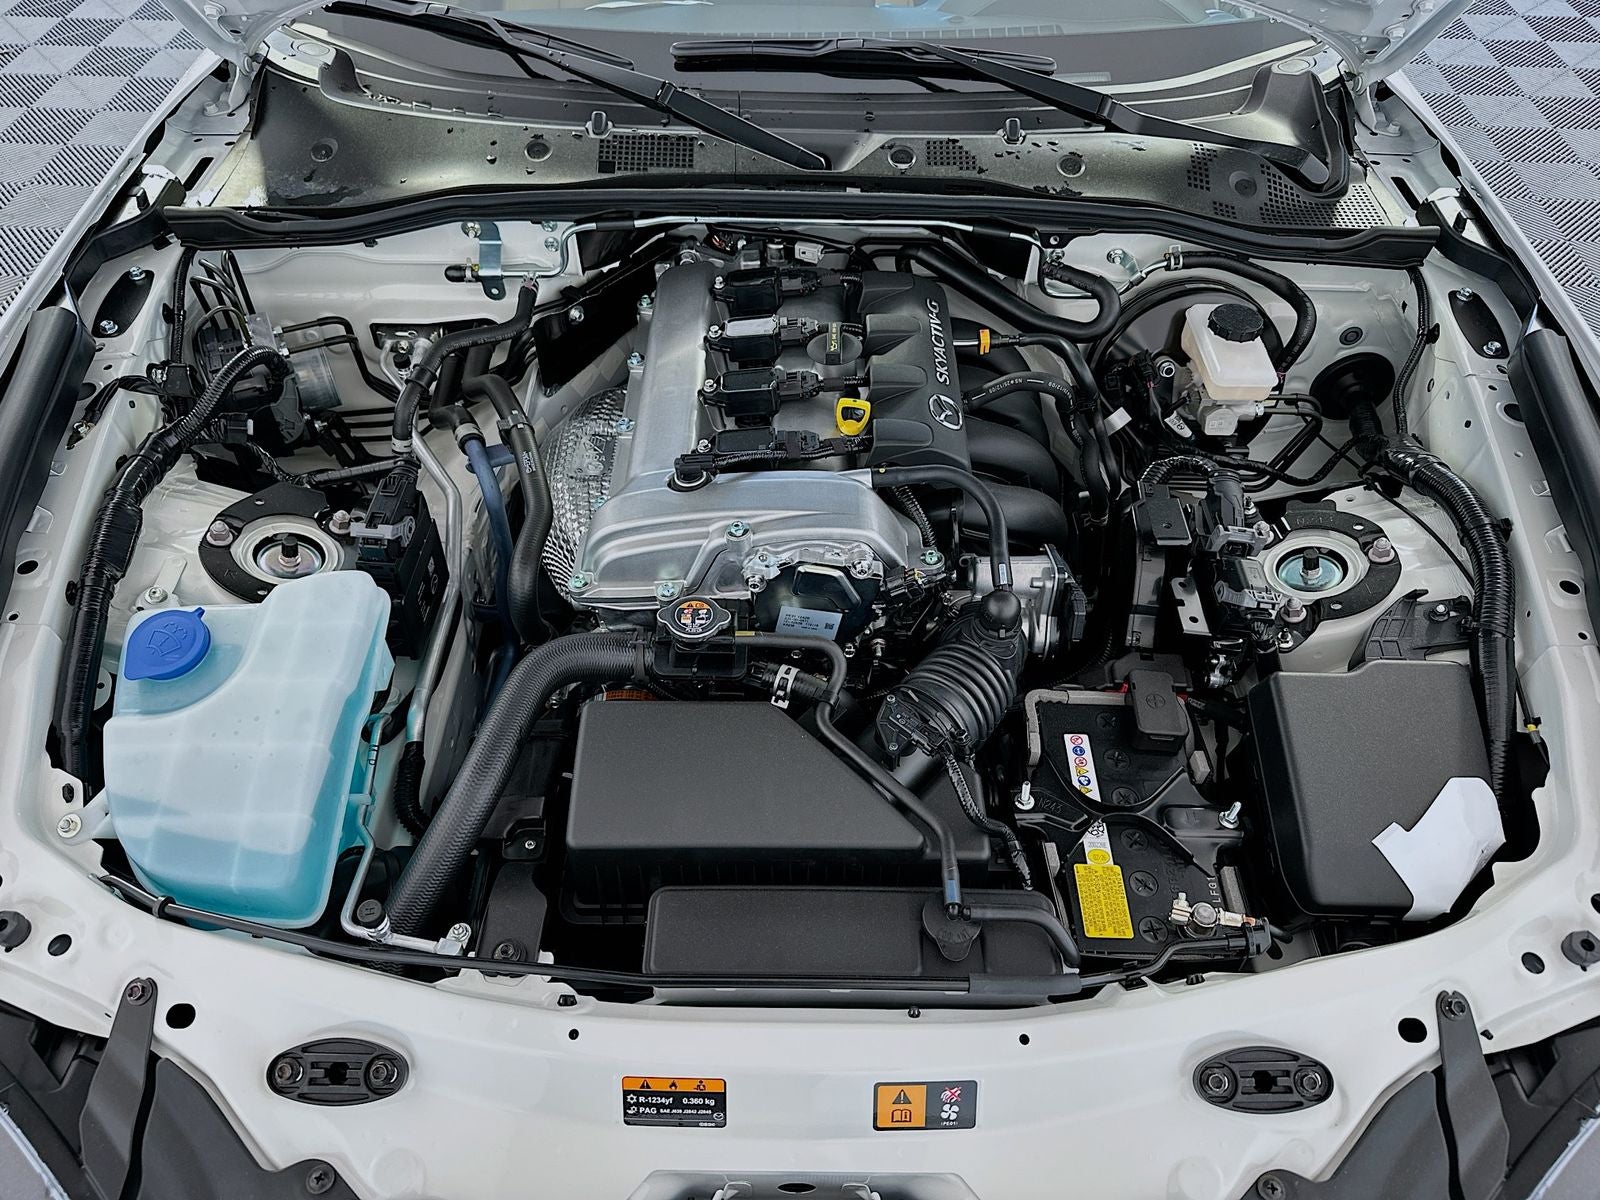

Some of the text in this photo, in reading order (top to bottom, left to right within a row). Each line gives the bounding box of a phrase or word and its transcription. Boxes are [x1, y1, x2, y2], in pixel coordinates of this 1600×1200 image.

[926, 298, 950, 385] SKYACTIV-G
[639, 1096, 673, 1105] R-1234yf
[705, 1098, 715, 1106] kg
